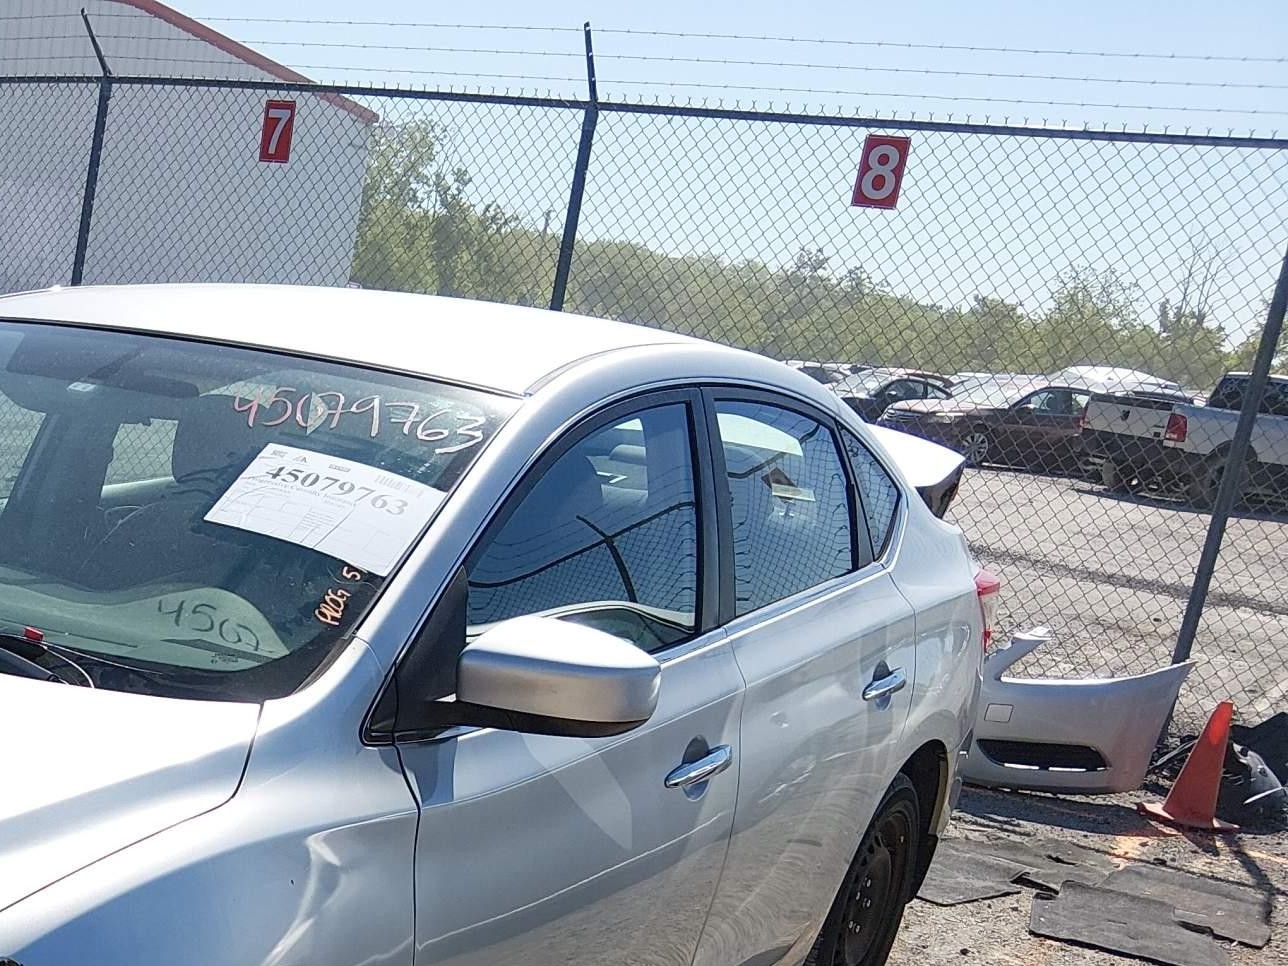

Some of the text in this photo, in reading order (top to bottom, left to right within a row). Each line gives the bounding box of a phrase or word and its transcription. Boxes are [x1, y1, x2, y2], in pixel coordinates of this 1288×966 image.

[268, 109, 292, 154] 7
[861, 144, 900, 200] 8
[232, 386, 487, 455] 45079763
[265, 465, 409, 516] 45079763
